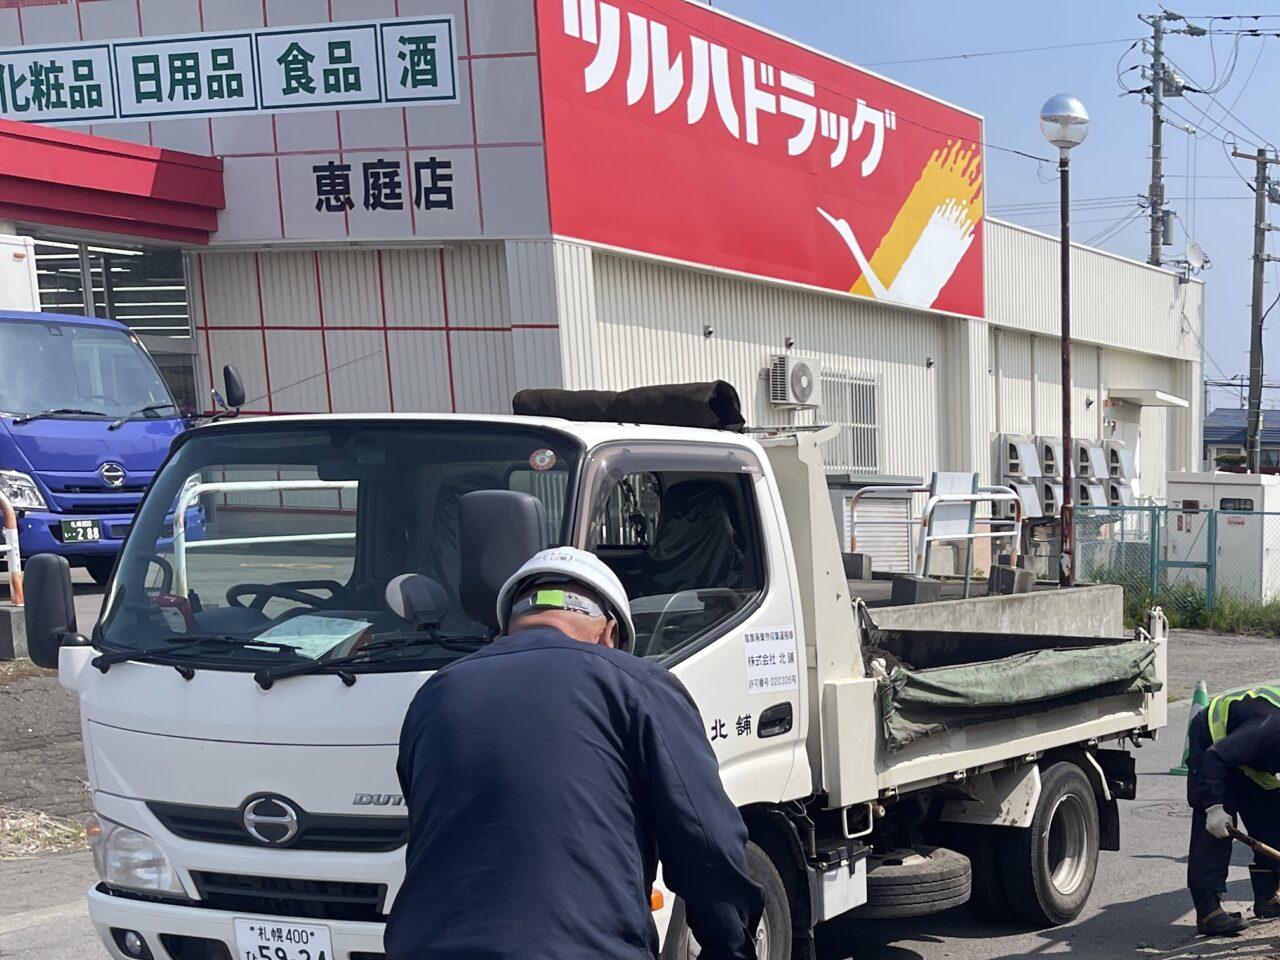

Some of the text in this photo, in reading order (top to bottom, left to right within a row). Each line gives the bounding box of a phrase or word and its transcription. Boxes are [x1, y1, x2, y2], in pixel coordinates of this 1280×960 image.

[0, 35, 437, 113] 化粧品 日用品 食品 酒
[562, 0, 896, 178] ツルハドラッグ
[313, 157, 455, 213] 恵庭店
[352, 793, 408, 806] DUT
